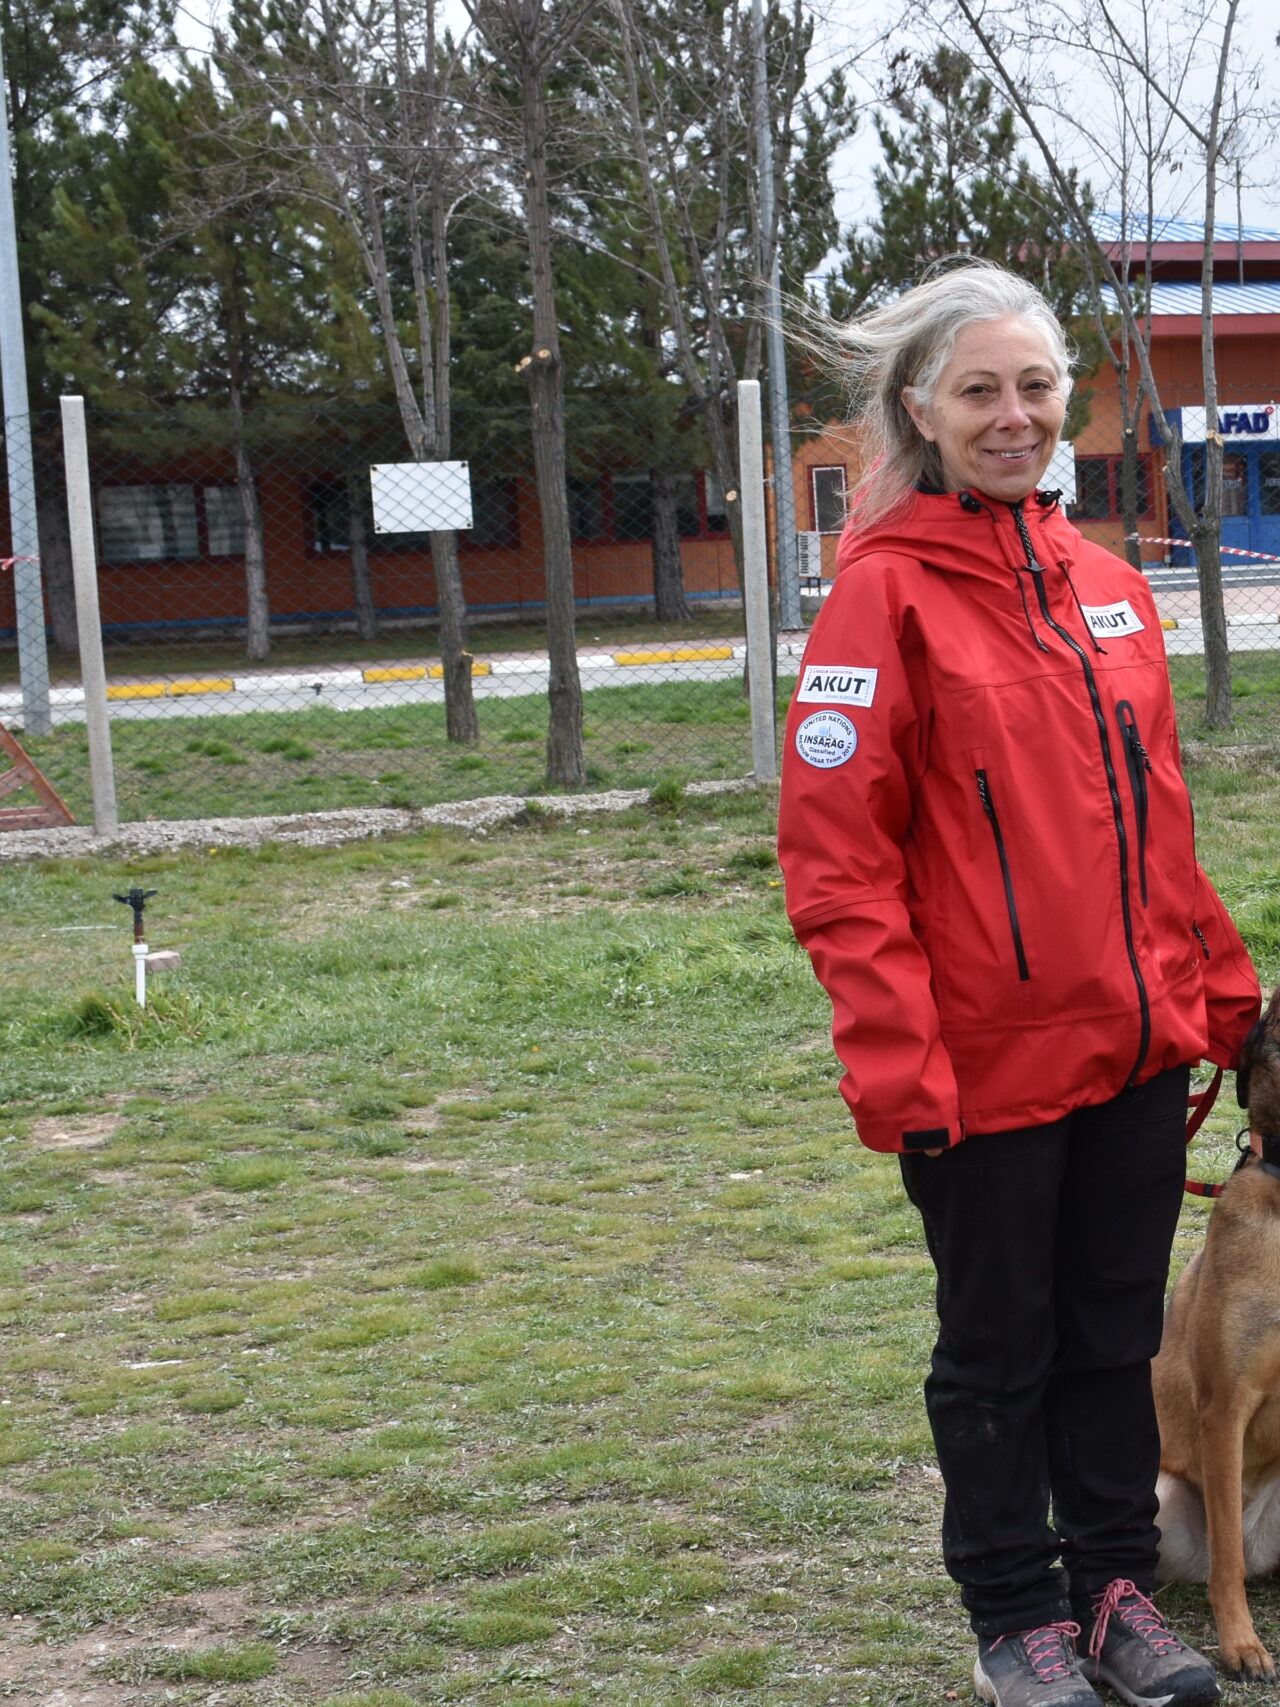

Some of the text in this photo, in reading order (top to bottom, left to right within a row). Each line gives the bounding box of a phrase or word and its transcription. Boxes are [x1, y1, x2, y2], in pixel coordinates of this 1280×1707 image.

[1089, 611, 1128, 629] AKUT
[807, 675, 866, 695] AKUT
[803, 715, 852, 736] UNITED NATIONS
[803, 734, 845, 749] INSARAG
[809, 746, 836, 756] Classified
